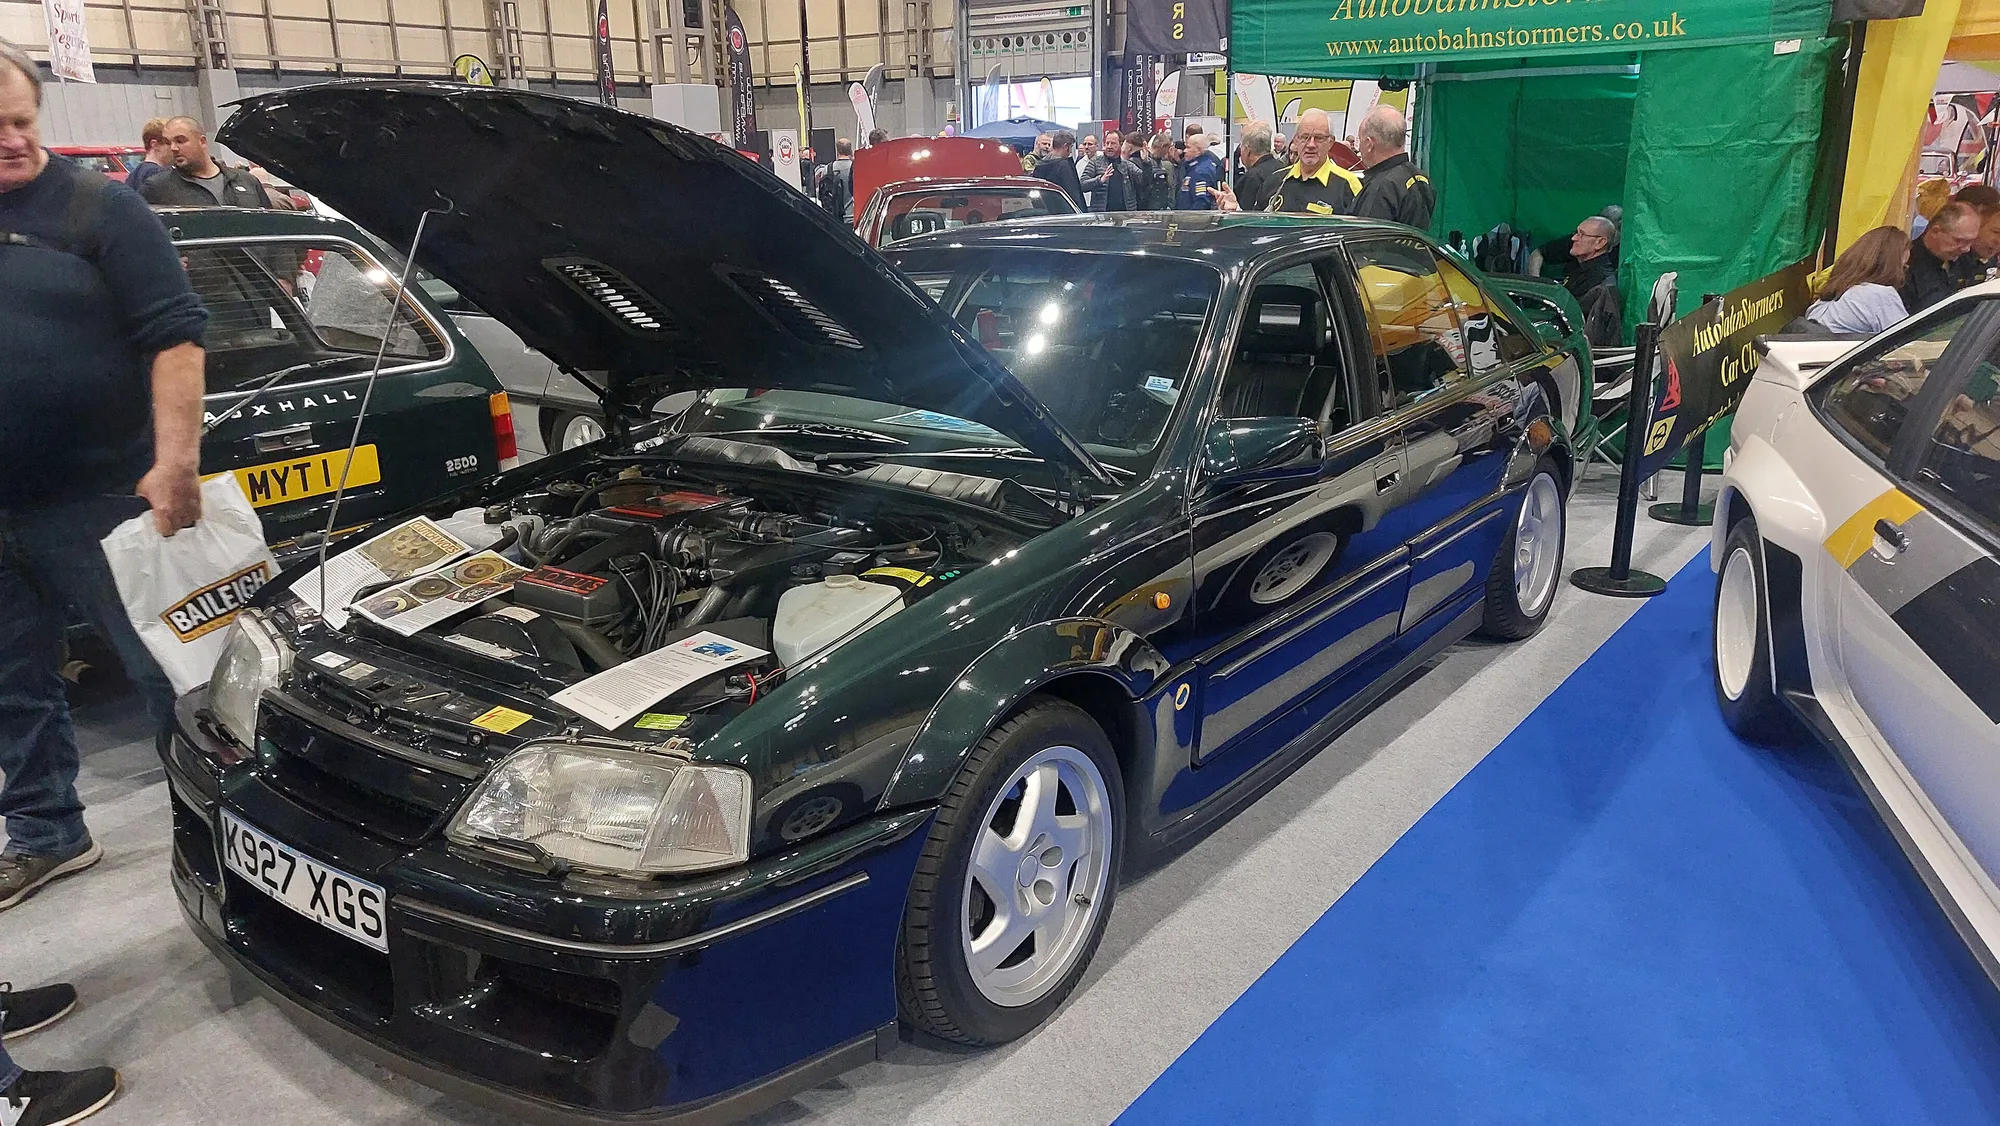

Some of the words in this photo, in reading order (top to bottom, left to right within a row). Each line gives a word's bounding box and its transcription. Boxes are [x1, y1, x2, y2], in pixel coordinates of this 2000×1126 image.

[1325, 12, 1687, 57] www.autobahnstormers.co.uk
[1136, 54, 1144, 85] CLUB
[1720, 355, 1740, 388] Car
[203, 390, 358, 423] AUXHALL
[445, 454, 478, 472] 2500
[247, 461, 312, 503] MYT
[168, 567, 267, 632] BAILEIGH
[223, 816, 297, 896] K927
[306, 863, 383, 939] XGS
